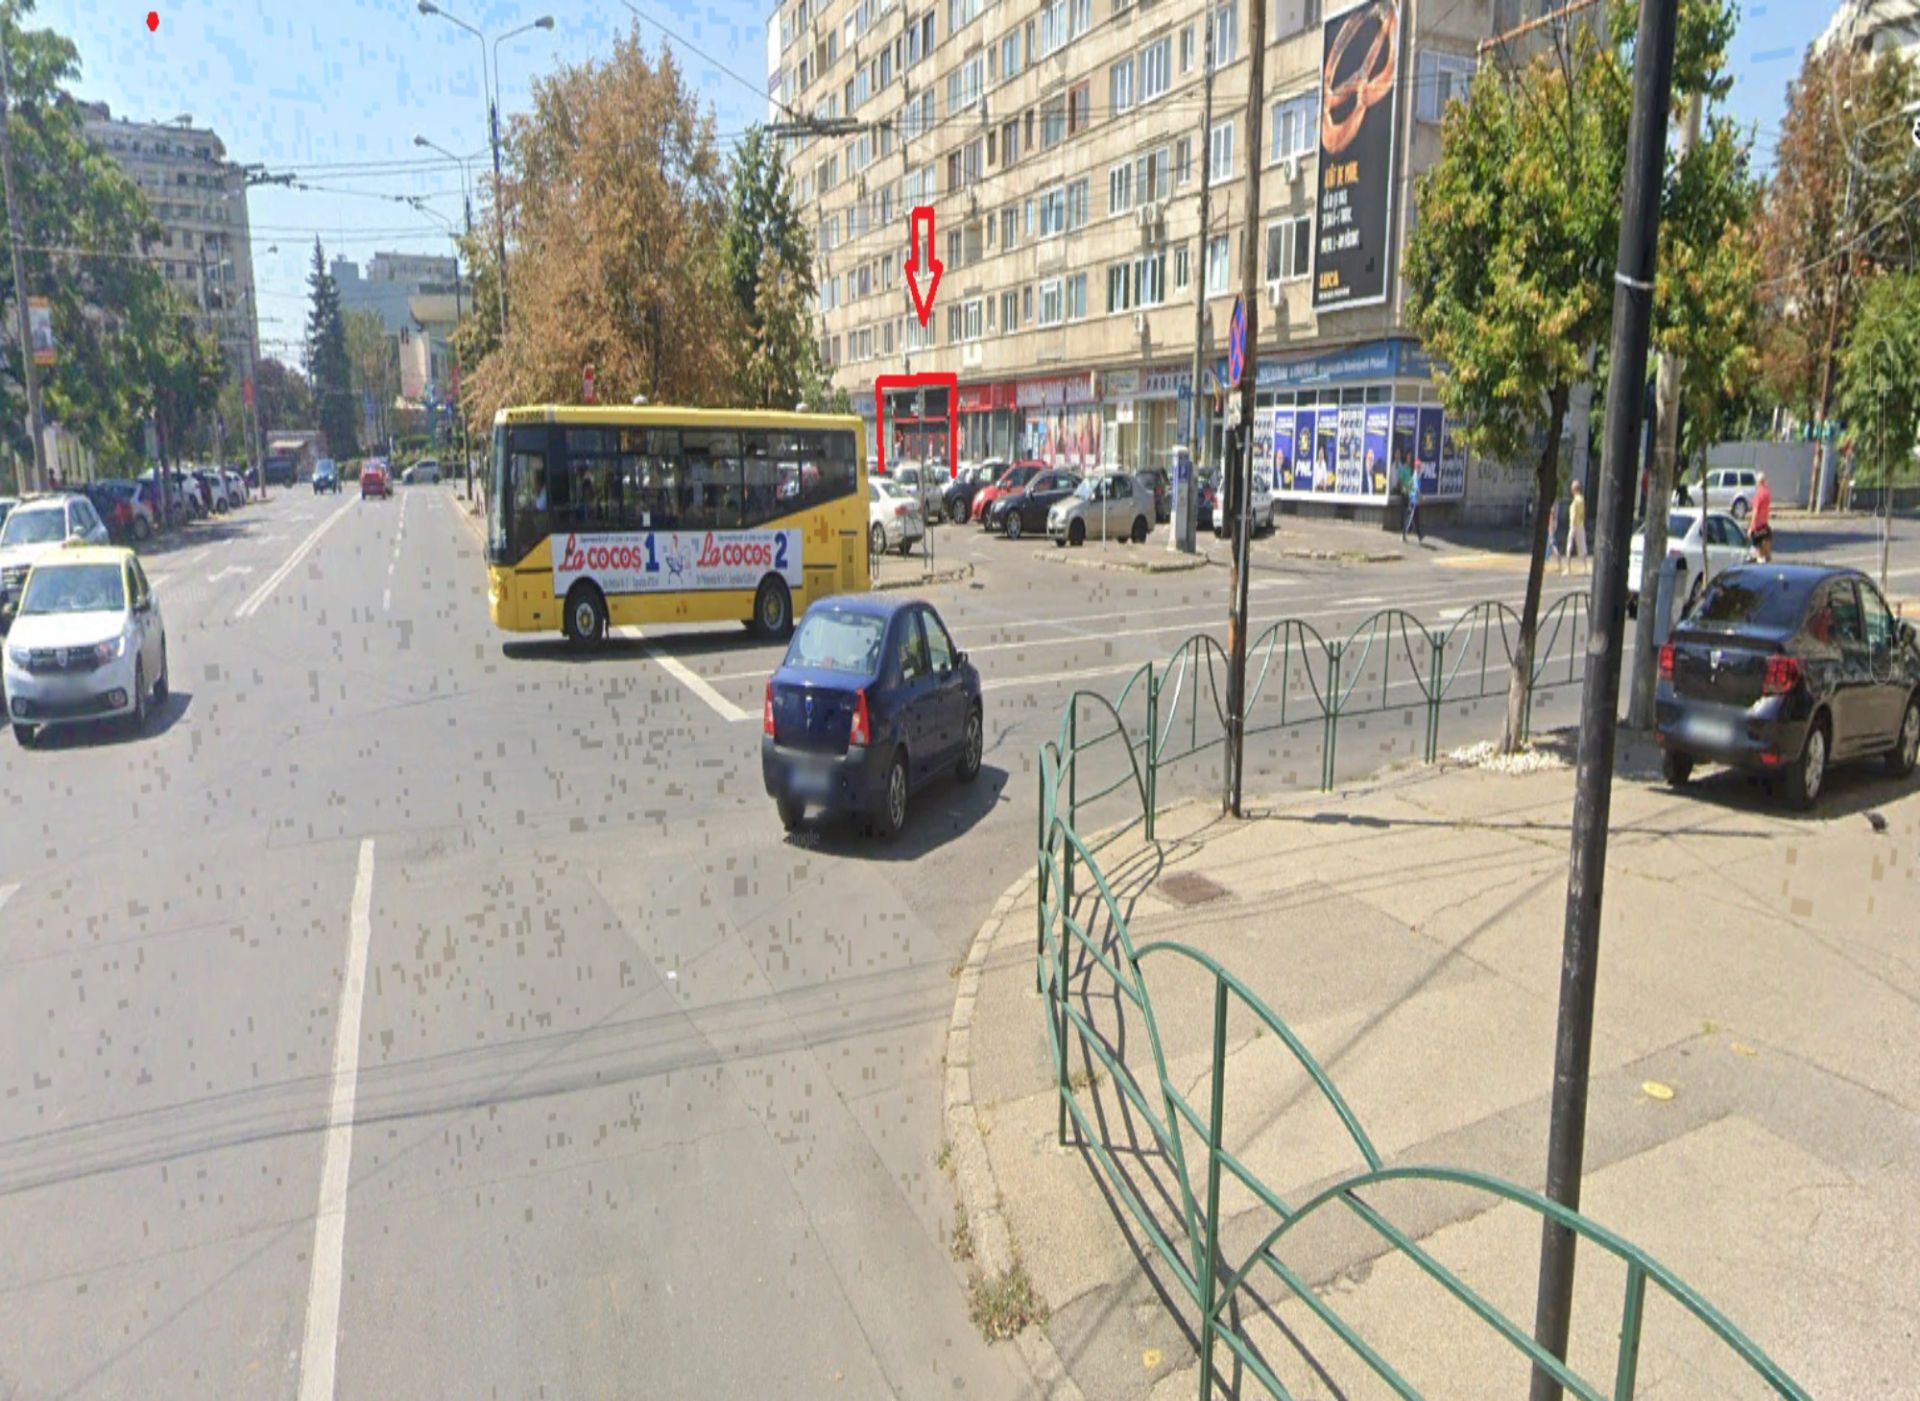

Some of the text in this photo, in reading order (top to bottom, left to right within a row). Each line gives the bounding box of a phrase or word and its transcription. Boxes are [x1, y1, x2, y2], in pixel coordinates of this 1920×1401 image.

[558, 530, 586, 572] La
[644, 530, 660, 572] 1
[696, 529, 721, 568] La
[774, 530, 789, 569] 2
